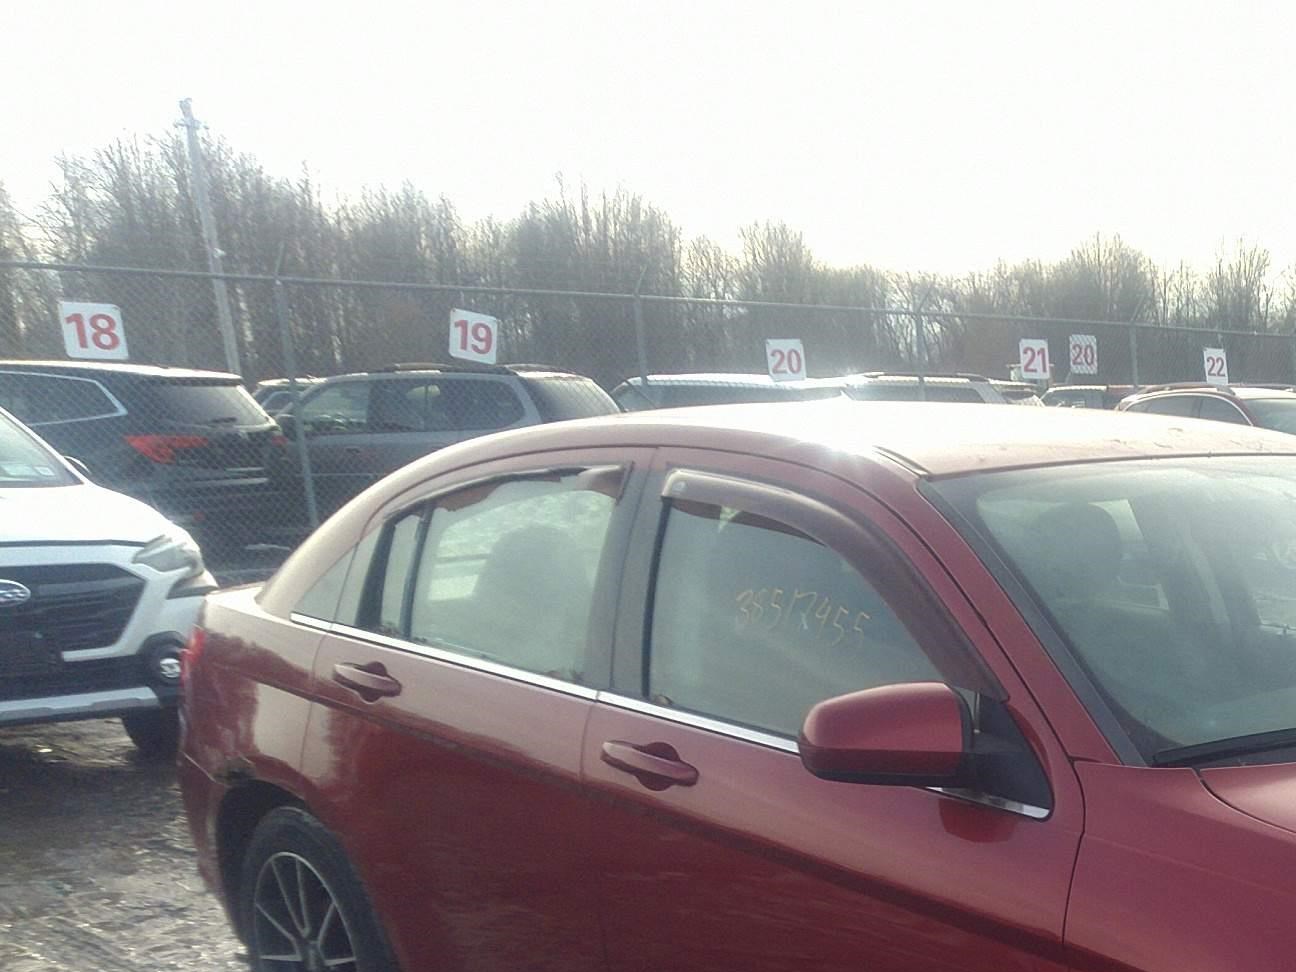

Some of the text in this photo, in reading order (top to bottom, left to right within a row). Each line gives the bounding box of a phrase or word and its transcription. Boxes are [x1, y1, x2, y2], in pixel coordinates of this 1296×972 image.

[64, 312, 121, 348] 18
[453, 318, 494, 355] 19
[769, 347, 803, 375] 20
[1022, 346, 1048, 374] 21
[1071, 343, 1095, 367] 20
[1206, 356, 1226, 377] 22
